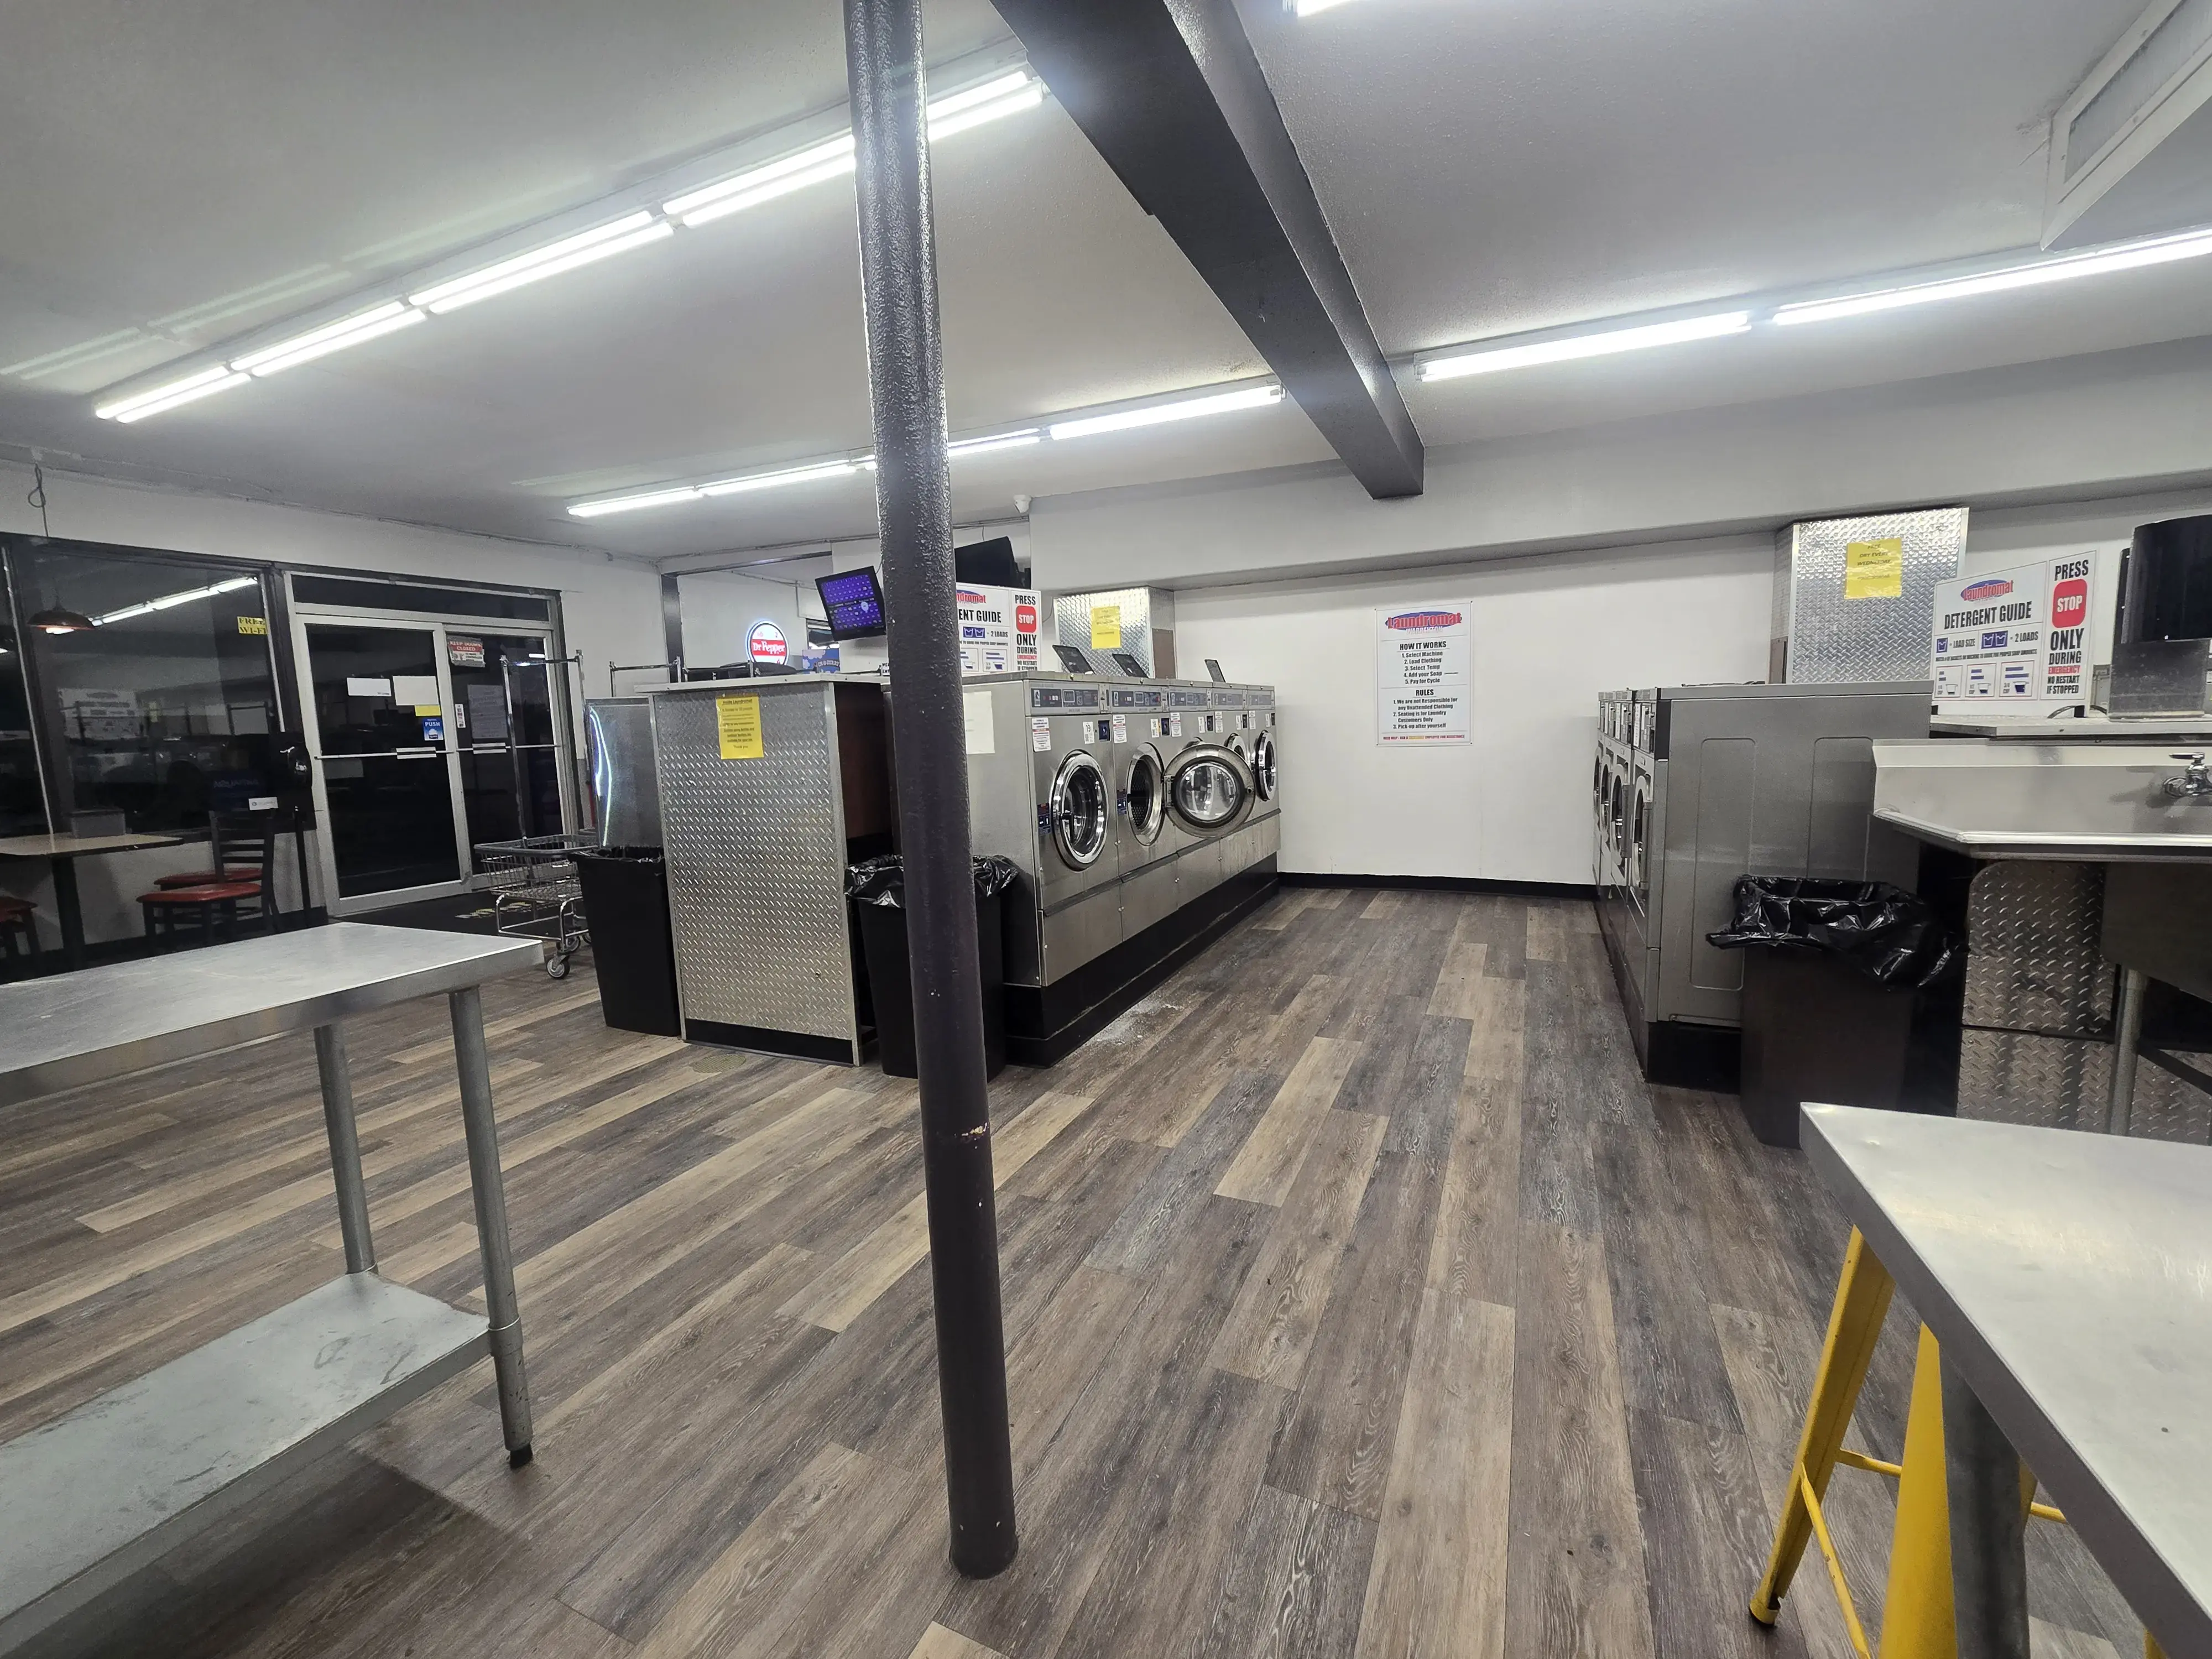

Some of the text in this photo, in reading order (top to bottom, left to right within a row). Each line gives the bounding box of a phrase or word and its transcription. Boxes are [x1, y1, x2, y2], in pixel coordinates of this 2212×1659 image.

[2054, 559, 2089, 581] PRESS
[1964, 580, 2014, 601] Laundromat
[957, 592, 987, 604] ndromat
[1015, 594, 1036, 606] PRESS
[2057, 595, 2083, 613] STOP
[977, 611, 1001, 623] GUIDE
[1019, 614, 1034, 624] STOP
[1388, 612, 1462, 629] Laundromat
[1944, 601, 2032, 629] DETERGENT GUIDE
[1016, 634, 1037, 646] ONLY
[1953, 639, 1964, 648] LOAD
[1965, 638, 1975, 647] SIZE
[2015, 634, 2019, 643] 2
[2020, 631, 2039, 642] LOADS
[2051, 628, 2085, 651] ONLY
[752, 640, 785, 655] Dr Pepper
[2048, 650, 2081, 665] DURING
[2047, 675, 2080, 684] NO RESTART
[2047, 685, 2079, 694] IF STOPPED
